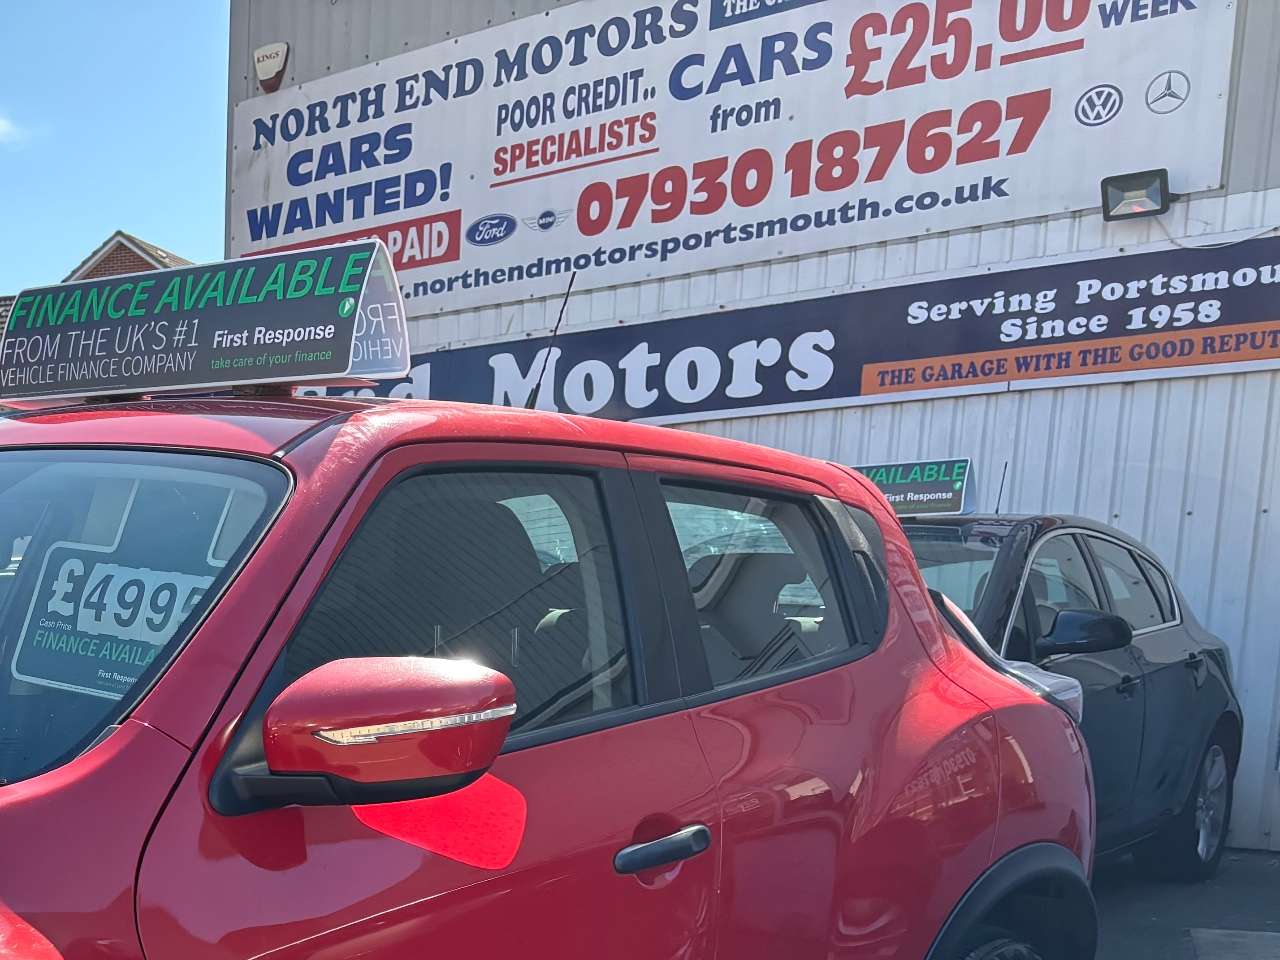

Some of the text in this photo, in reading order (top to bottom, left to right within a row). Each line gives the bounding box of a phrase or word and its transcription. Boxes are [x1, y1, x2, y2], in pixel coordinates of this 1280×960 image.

[253, 0, 699, 151] NORTH END MOTORS
[669, 21, 833, 100] CARS
[496, 83, 556, 136] POOR
[710, 97, 781, 134] from
[287, 122, 413, 187] CARS
[493, 112, 658, 177] SPECIALISTS
[577, 88, 1053, 237] 07930 187627
[247, 162, 453, 242] WANTED!
[387, 221, 450, 264] PAID
[401, 175, 1010, 299] .northendmotorsportsmouth.co.uk
[475, 219, 508, 241] Ford
[8, 279, 156, 331] FINANCE
[153, 251, 371, 314] AVAILABLE
[906, 288, 1058, 325] Serving
[1, 333, 61, 366] FROM
[67, 327, 111, 358] THE
[172, 318, 199, 348] #1
[213, 323, 336, 349] First Response
[999, 299, 1222, 342] Since 1958
[0, 350, 197, 387] VEHICLE FINANCE COMPANY
[211, 349, 333, 369] take care of your finance
[488, 329, 836, 415] Motors
[876, 367, 915, 387] THE
[921, 358, 1008, 383] GARAGE
[1014, 351, 1073, 373] WITH
[1078, 345, 1122, 367] THE
[1128, 338, 1195, 361] GOOD
[906, 492, 953, 503] Response
[32, 630, 100, 657] FINANCE
[97, 669, 112, 680] First
